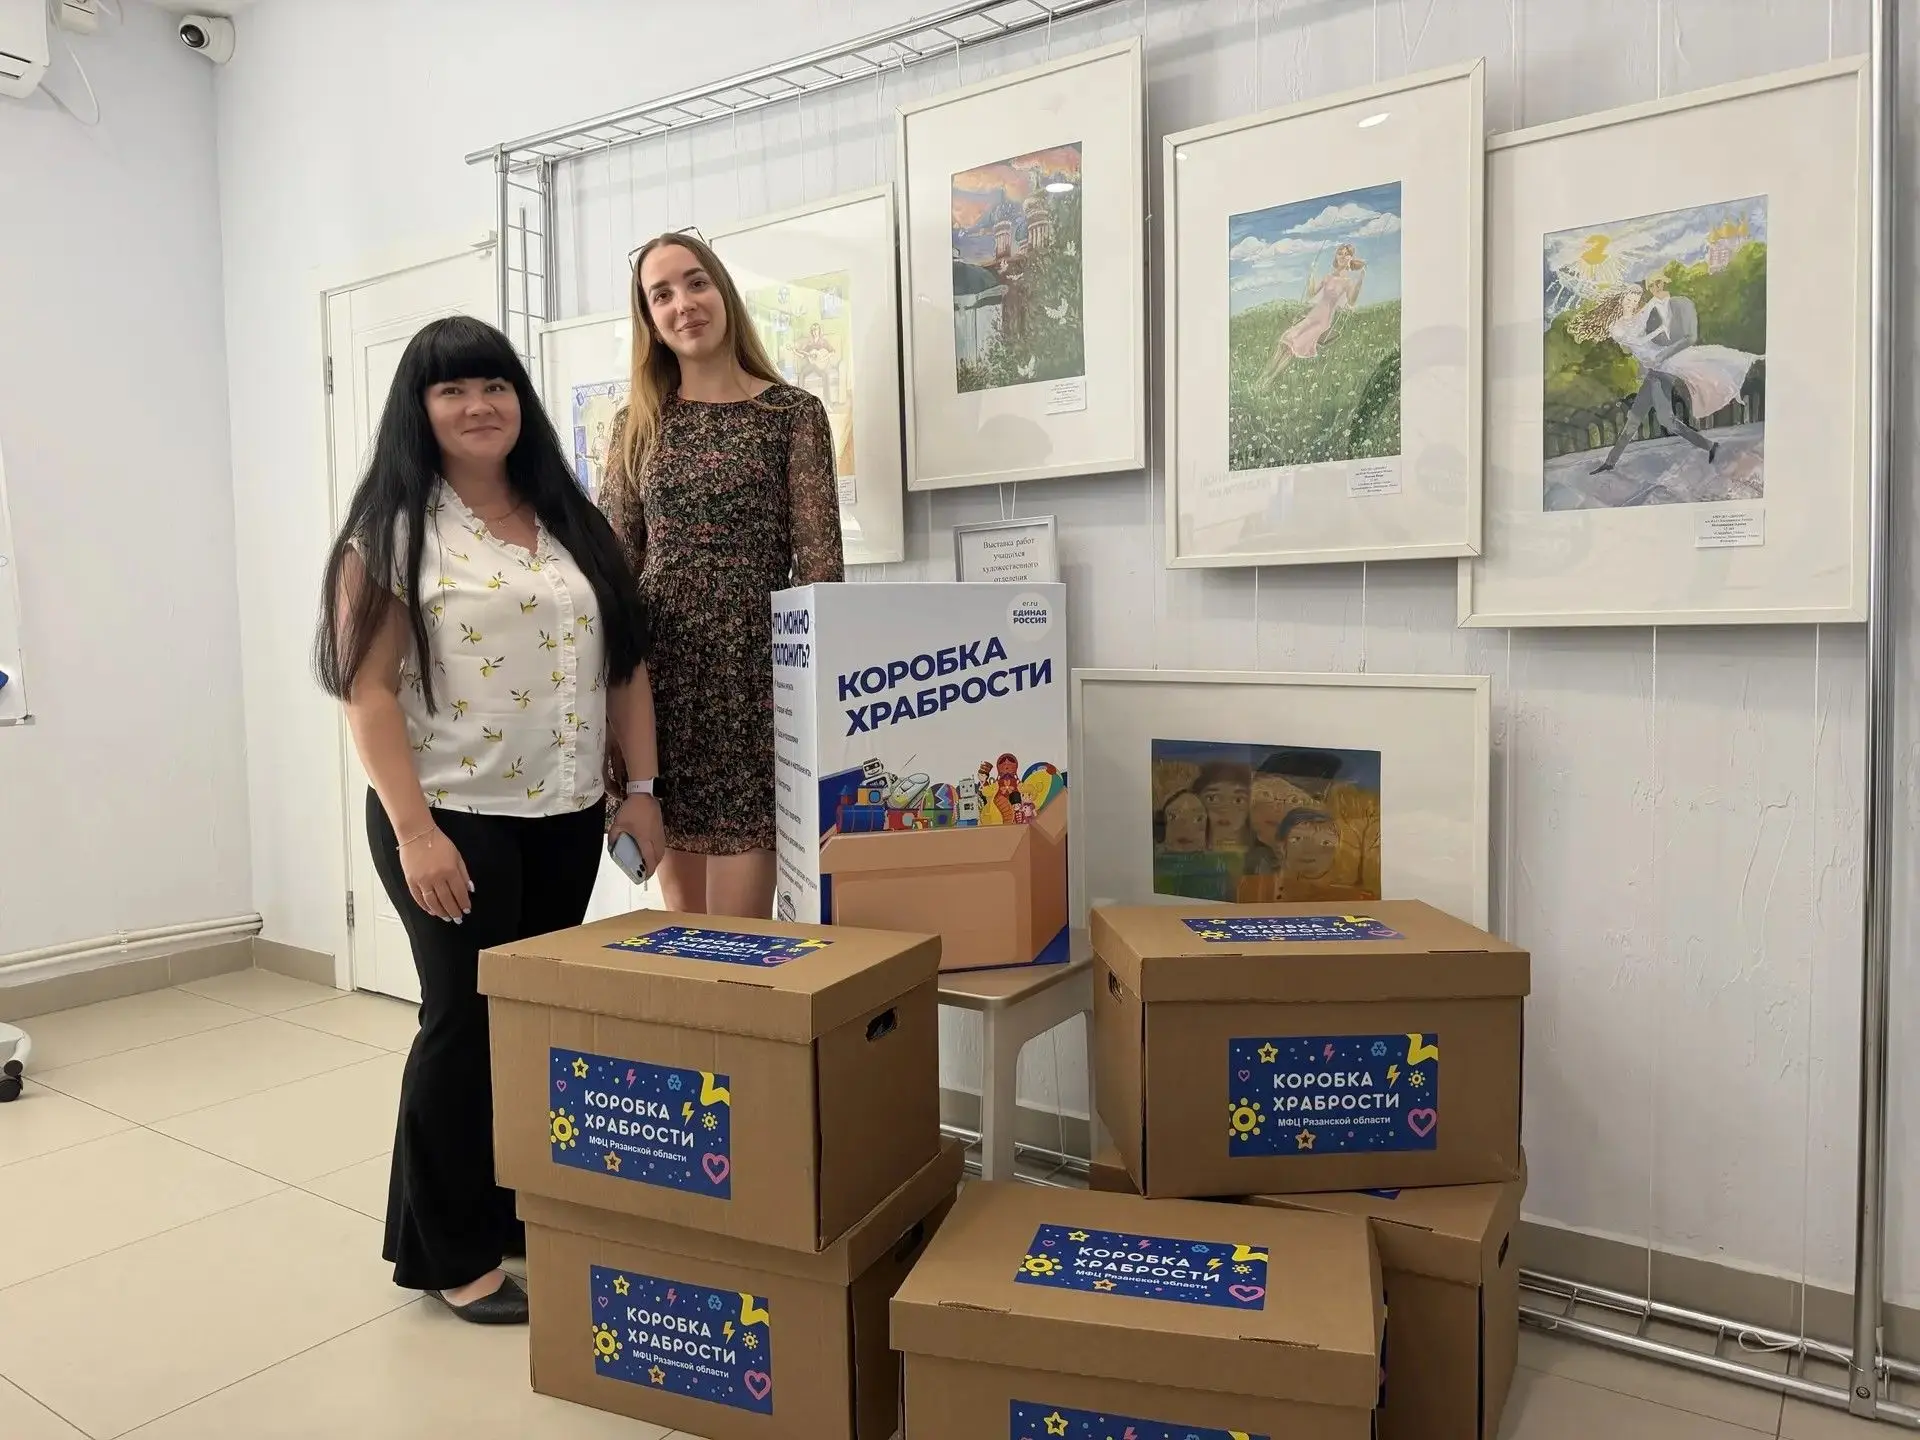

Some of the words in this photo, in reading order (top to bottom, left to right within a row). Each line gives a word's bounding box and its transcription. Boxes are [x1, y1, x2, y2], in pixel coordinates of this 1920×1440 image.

[983, 541, 1014, 549] Выставка
[1016, 537, 1035, 547] работ
[982, 562, 1039, 573] художественного
[783, 609, 810, 635] МОЖНО
[1012, 609, 1047, 617] ЕДИНАЯ
[838, 636, 1008, 702] КОРОБКА
[845, 657, 1052, 737] ХРАБРОСТИ
[1273, 1071, 1373, 1089] КОРОБКА
[584, 1089, 670, 1121] КОРОБКА
[1272, 1093, 1400, 1112] ХРАБРОСТИ
[584, 1113, 694, 1148] ХРАБРОСТИ
[1277, 1118, 1301, 1127] МФЦ
[1303, 1116, 1350, 1127] Рязанской
[1353, 1116, 1391, 1125] области
[589, 1135, 608, 1148] МФЦ
[610, 1140, 651, 1156] Рязанской
[653, 1150, 687, 1162] области
[1078, 1246, 1190, 1268] КОРОБКА
[1073, 1258, 1220, 1283] ХРАБРОСТИ
[1075, 1269, 1101, 1279] МФЦ
[1104, 1273, 1160, 1285] Рязанской
[1163, 1280, 1208, 1290] области
[627, 1306, 711, 1338] КОРОБКА
[627, 1328, 736, 1365] ХРАБРОСТИ
[632, 1349, 652, 1362] МФЦ
[653, 1355, 694, 1371] Рязанской
[696, 1365, 729, 1378] области
